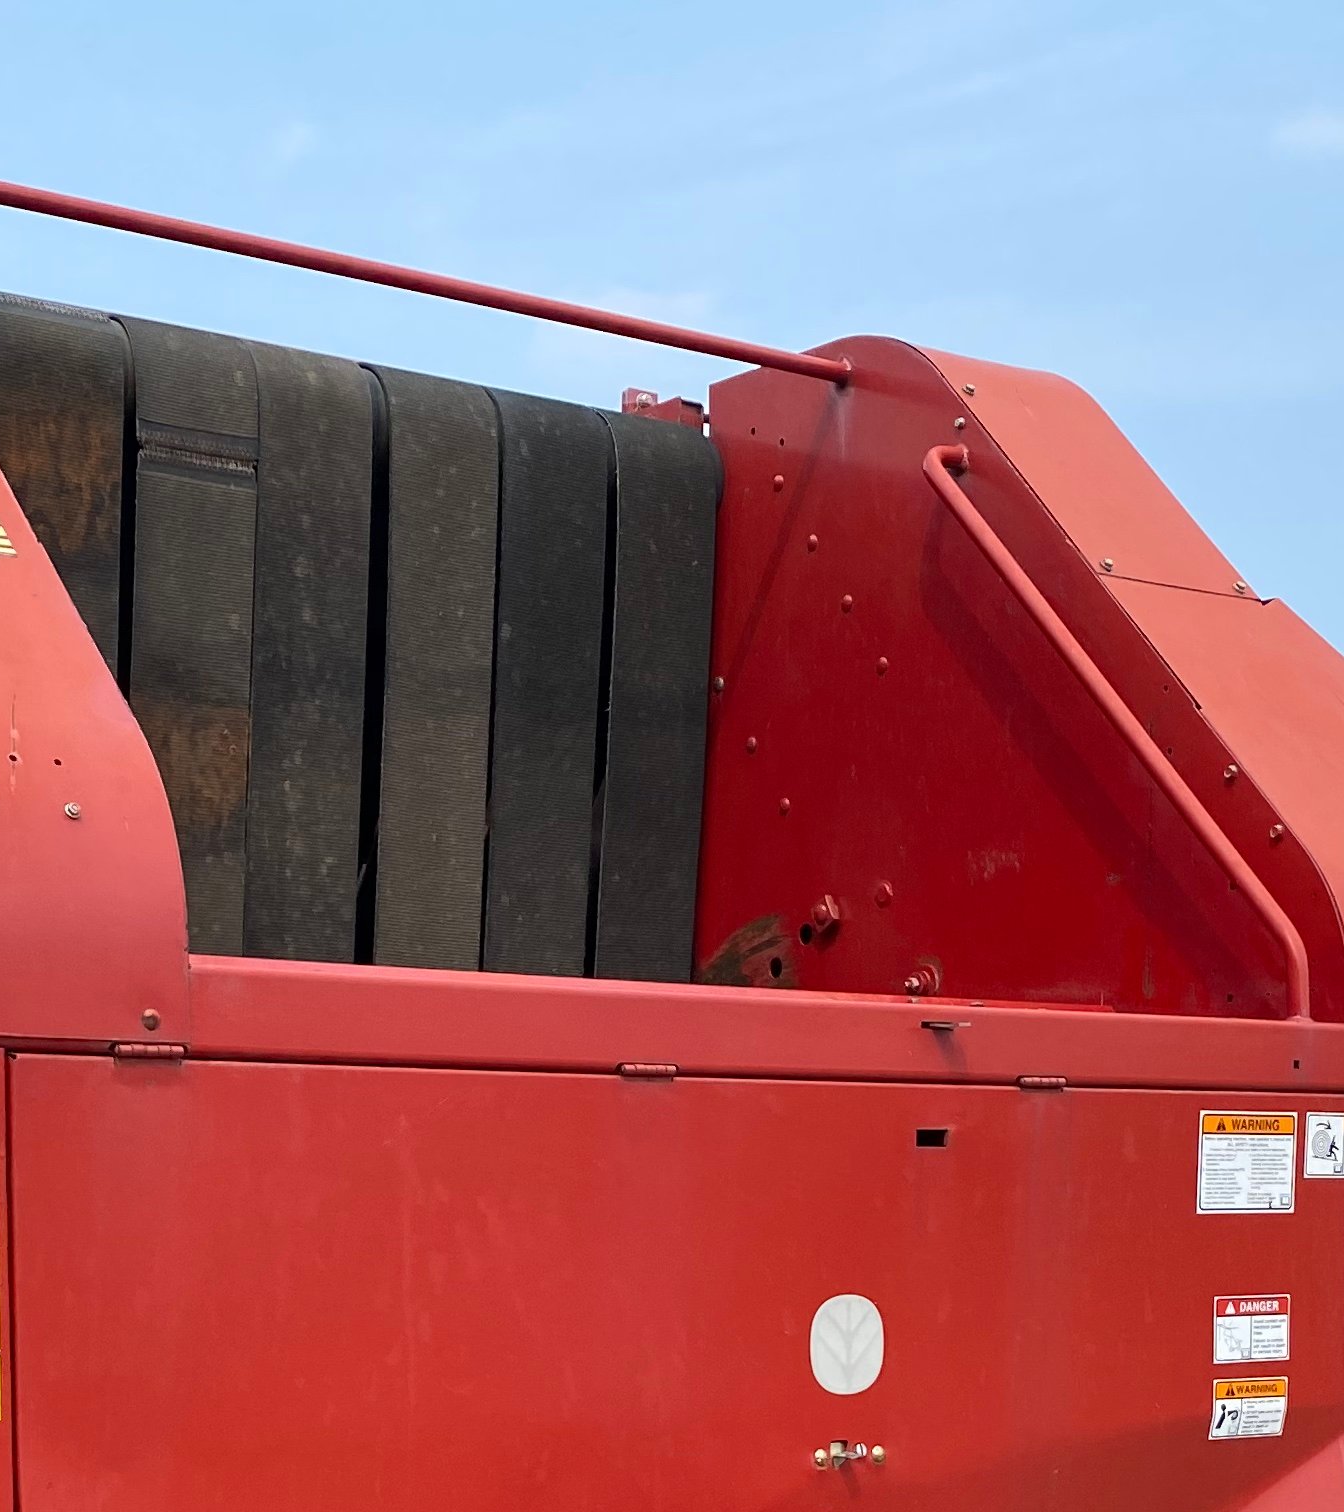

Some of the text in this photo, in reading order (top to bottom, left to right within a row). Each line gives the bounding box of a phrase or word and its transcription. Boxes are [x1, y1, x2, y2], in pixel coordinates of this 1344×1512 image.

[1231, 1118, 1280, 1131] WARNING
[1239, 1300, 1280, 1313] DANGER
[1236, 1384, 1278, 1395] WARNING
